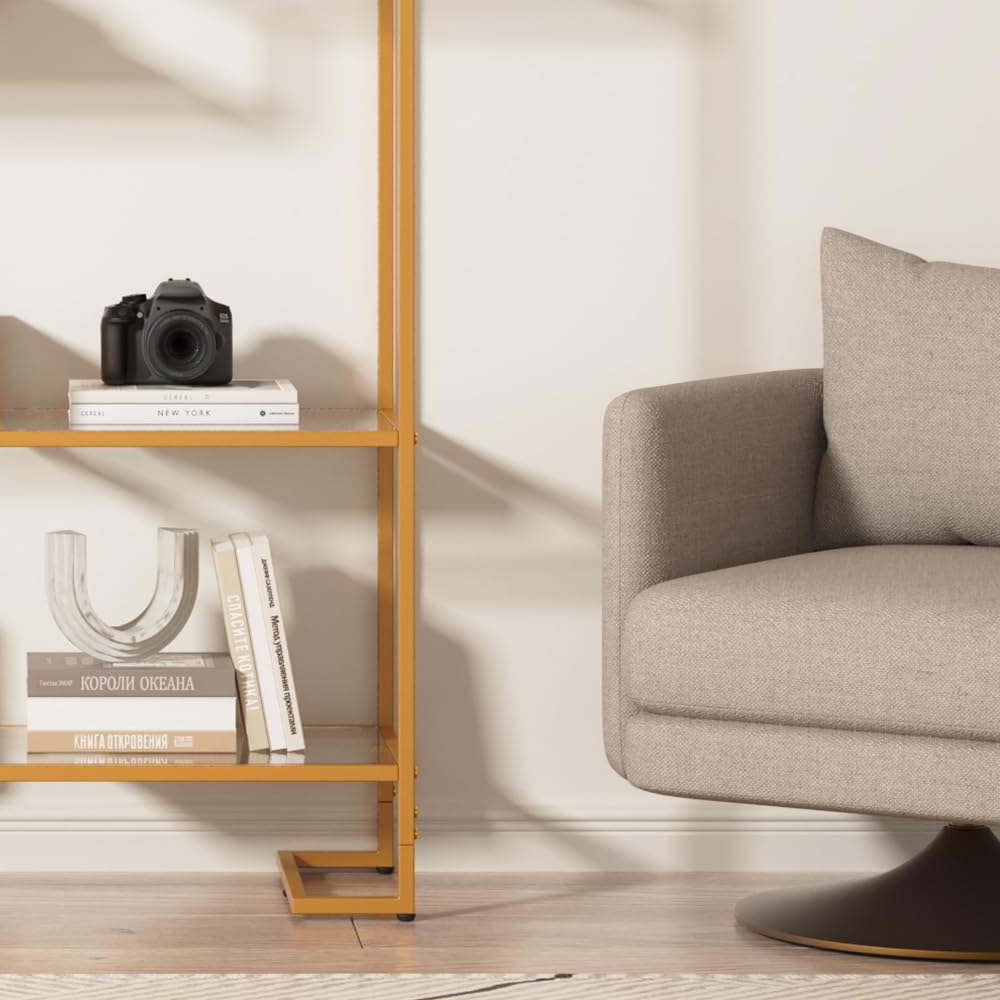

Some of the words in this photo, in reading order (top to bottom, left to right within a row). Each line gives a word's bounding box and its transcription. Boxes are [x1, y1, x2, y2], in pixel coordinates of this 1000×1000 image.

[157, 409, 180, 417] NEW
[185, 409, 212, 417] YORK
[226, 594, 249, 652] СПАСИТЕ
[271, 615, 279, 641] Метод
[274, 641, 289, 691] управления
[81, 675, 135, 692] КОРОЛИ
[140, 675, 195, 692] ОКЕАНА
[284, 692, 297, 735] проектами
[74, 733, 105, 750] КНИГА
[107, 733, 168, 750] ОТКРОВЕНИЯ
